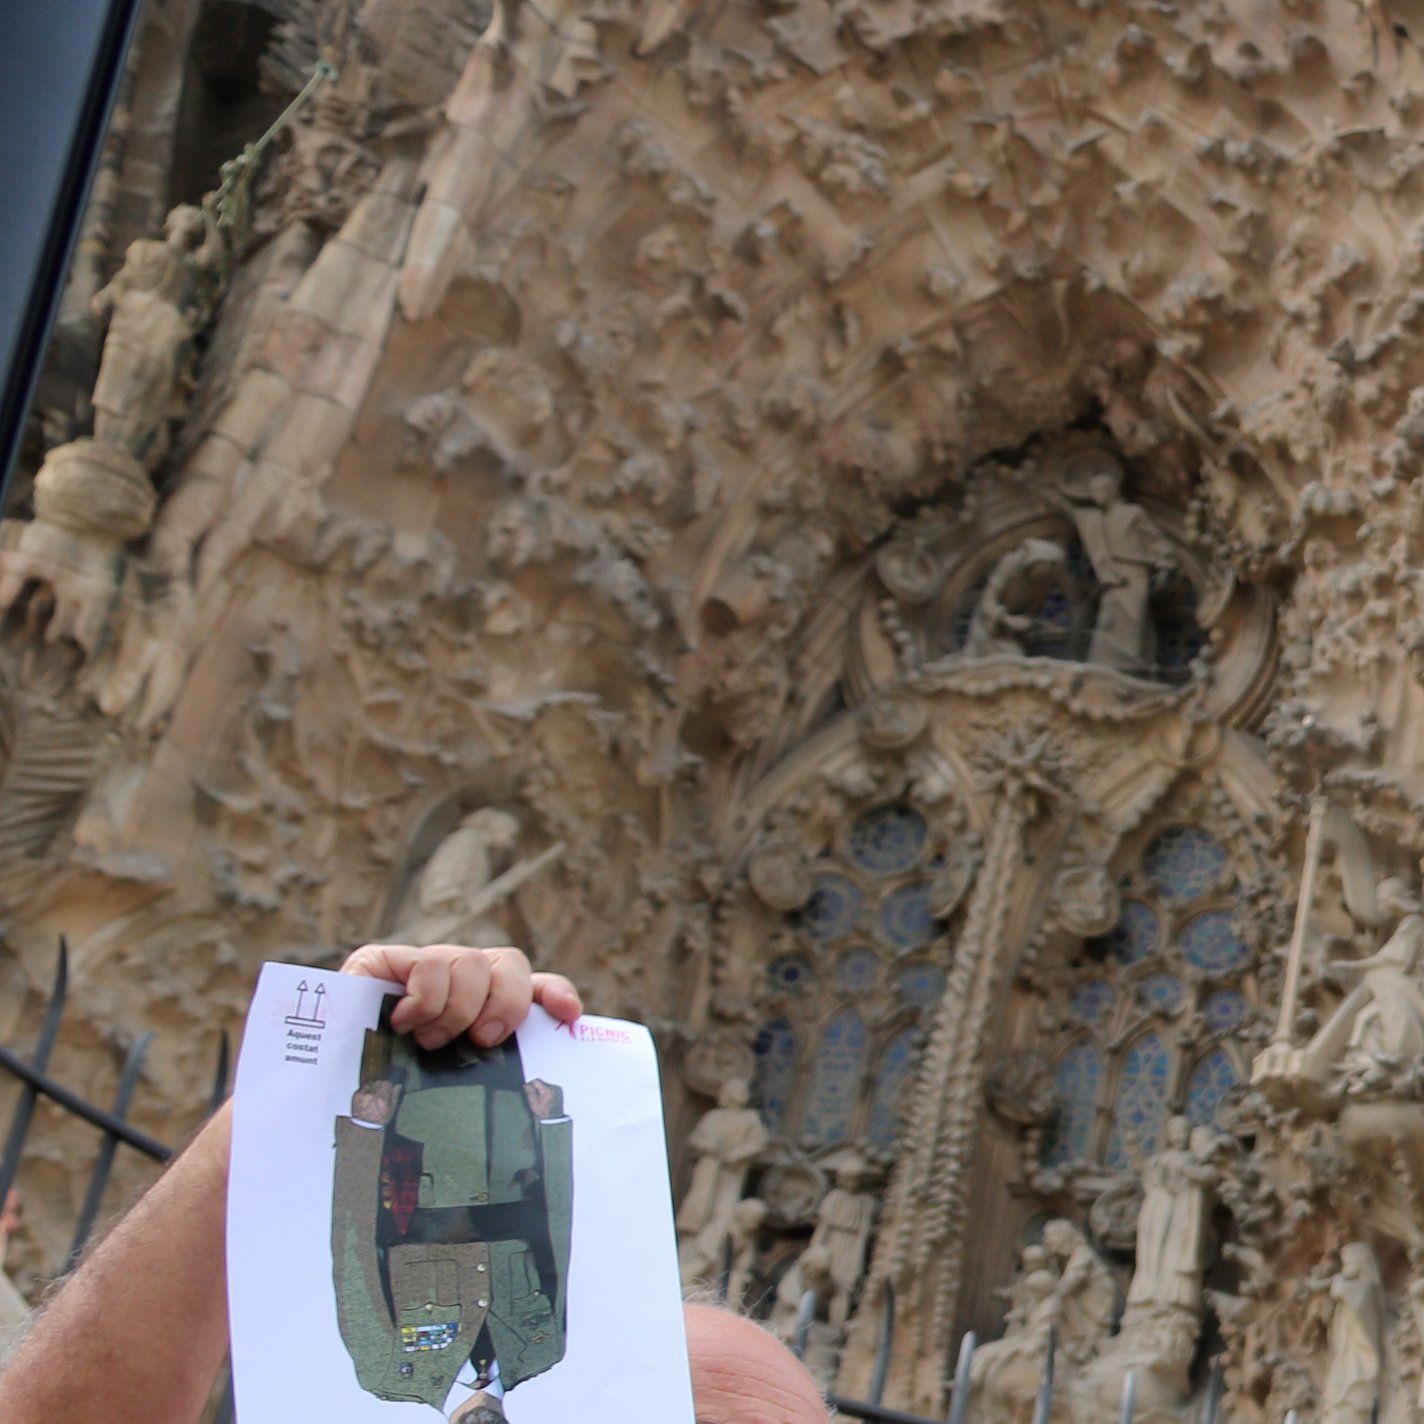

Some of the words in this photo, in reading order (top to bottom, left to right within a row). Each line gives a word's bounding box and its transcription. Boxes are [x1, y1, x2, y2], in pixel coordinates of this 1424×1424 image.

[287, 1029, 322, 1042] Aquest
[579, 1024, 631, 1041] PICNIC
[286, 1042, 319, 1053] costat
[284, 1054, 318, 1065] amunt
